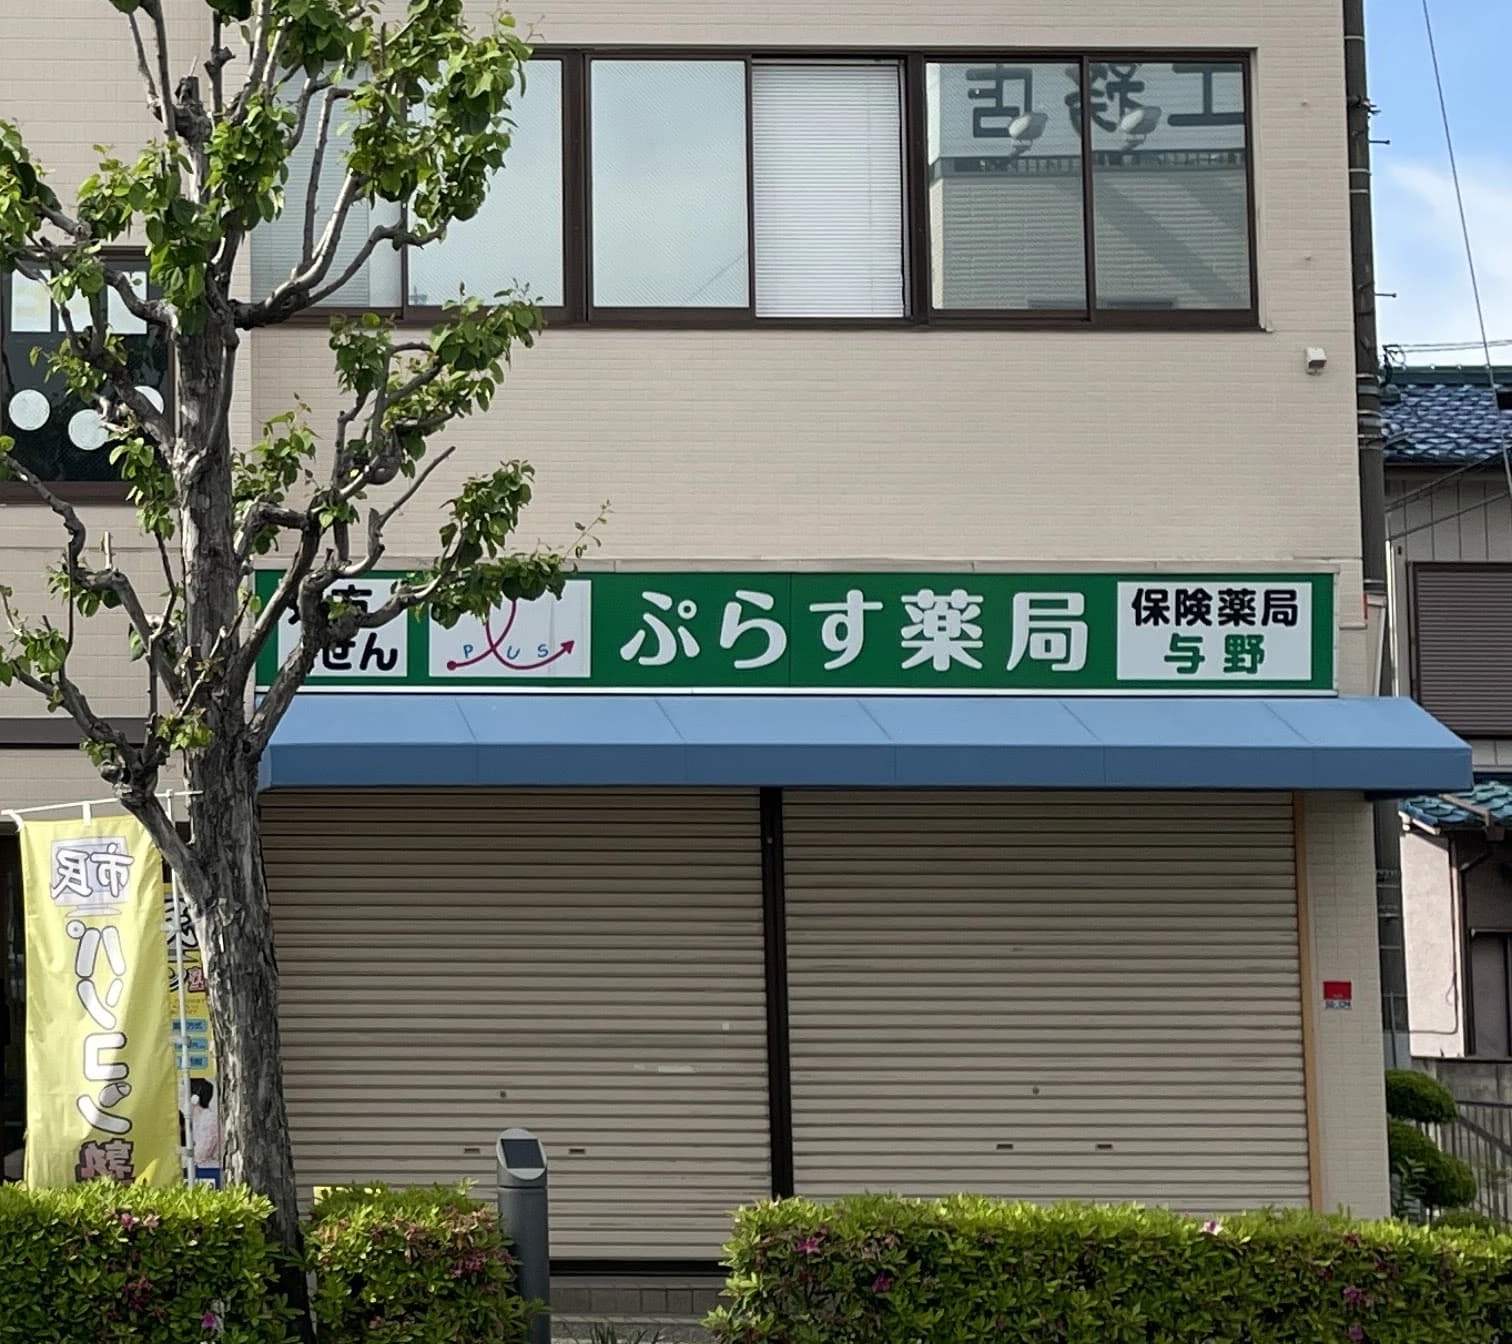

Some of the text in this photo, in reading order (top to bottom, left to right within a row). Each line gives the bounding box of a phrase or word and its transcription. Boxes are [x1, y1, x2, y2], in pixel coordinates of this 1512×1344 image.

[1131, 587, 1299, 628] 保険薬局
[619, 588, 1088, 673] ぷらす薬局
[1164, 632, 1266, 675] 与野
